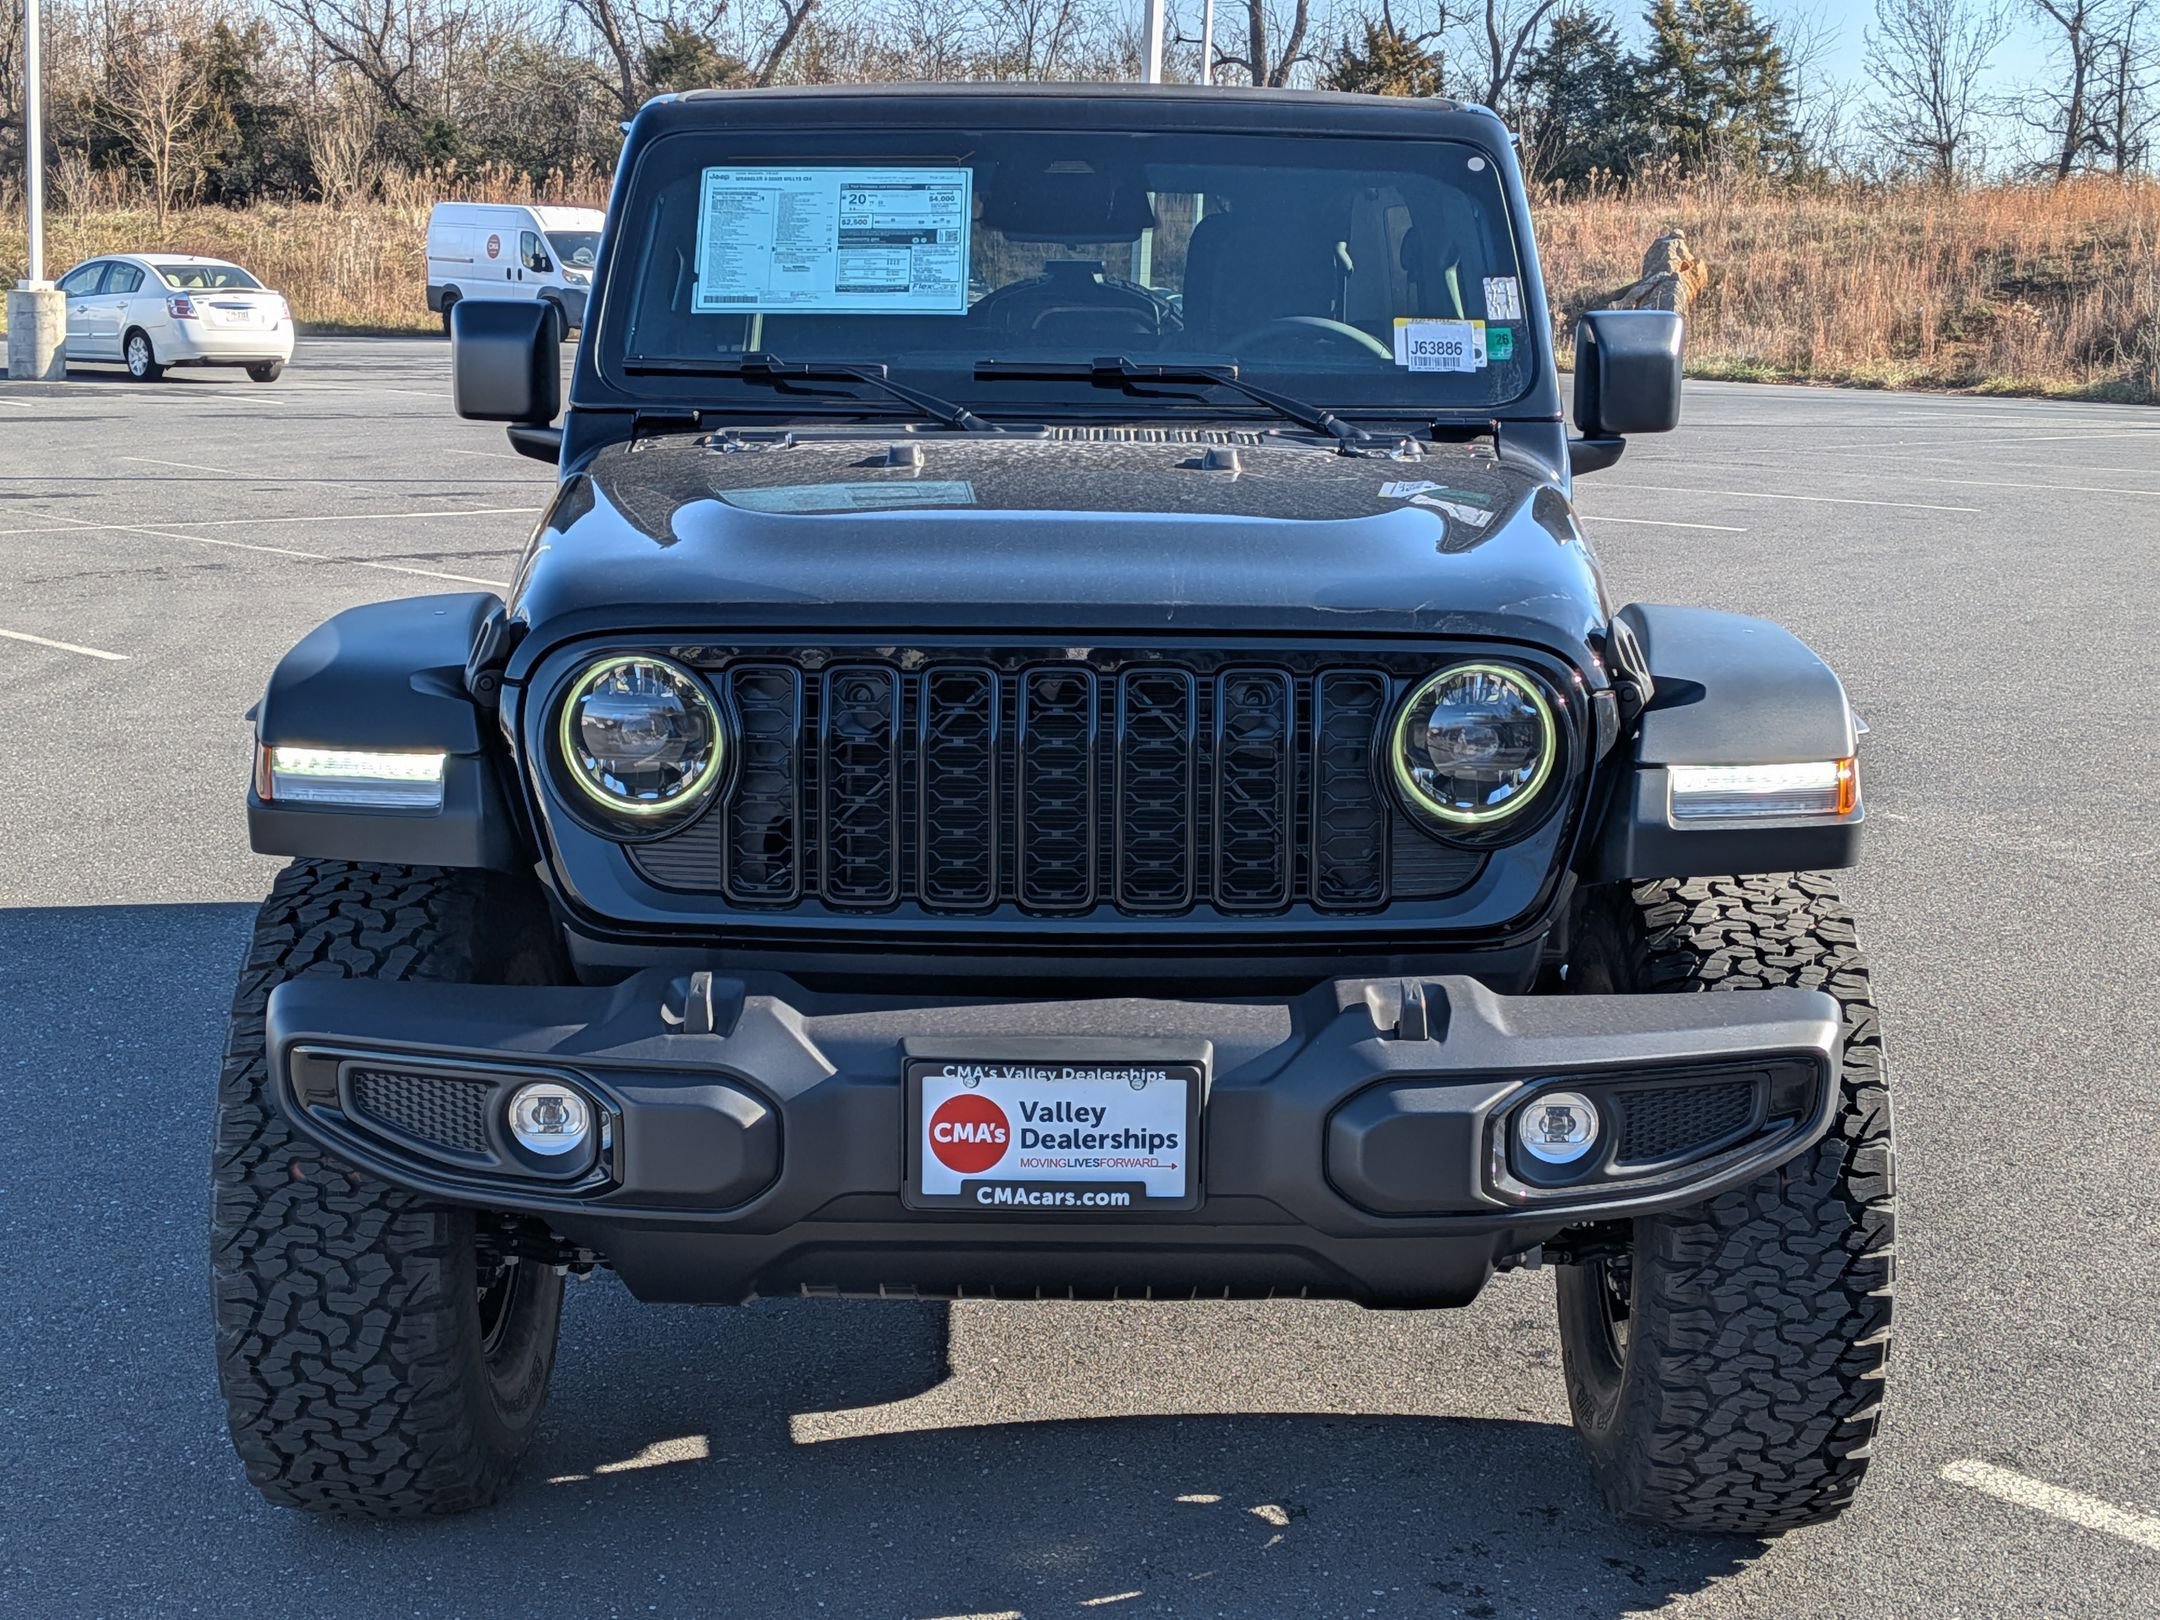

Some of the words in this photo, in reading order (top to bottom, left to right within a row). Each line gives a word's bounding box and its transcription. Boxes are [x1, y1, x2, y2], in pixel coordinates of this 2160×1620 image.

[709, 173, 730, 181] Jeep
[848, 193, 867, 205] 20
[928, 195, 956, 203] $4,000
[841, 218, 868, 226] $2,500
[912, 282, 957, 291] FlexCare
[1495, 333, 1509, 345] 26
[1410, 340, 1463, 356] J63886
[943, 1065, 998, 1079] CMA's
[1003, 1067, 1058, 1082] Valley
[1062, 1068, 1166, 1082] Dealerships
[1019, 1101, 1107, 1128] Valley
[933, 1122, 1007, 1144] CMA's
[1020, 1128, 1179, 1154] Dealerships
[976, 1186, 1131, 1207] CMAcars.com
